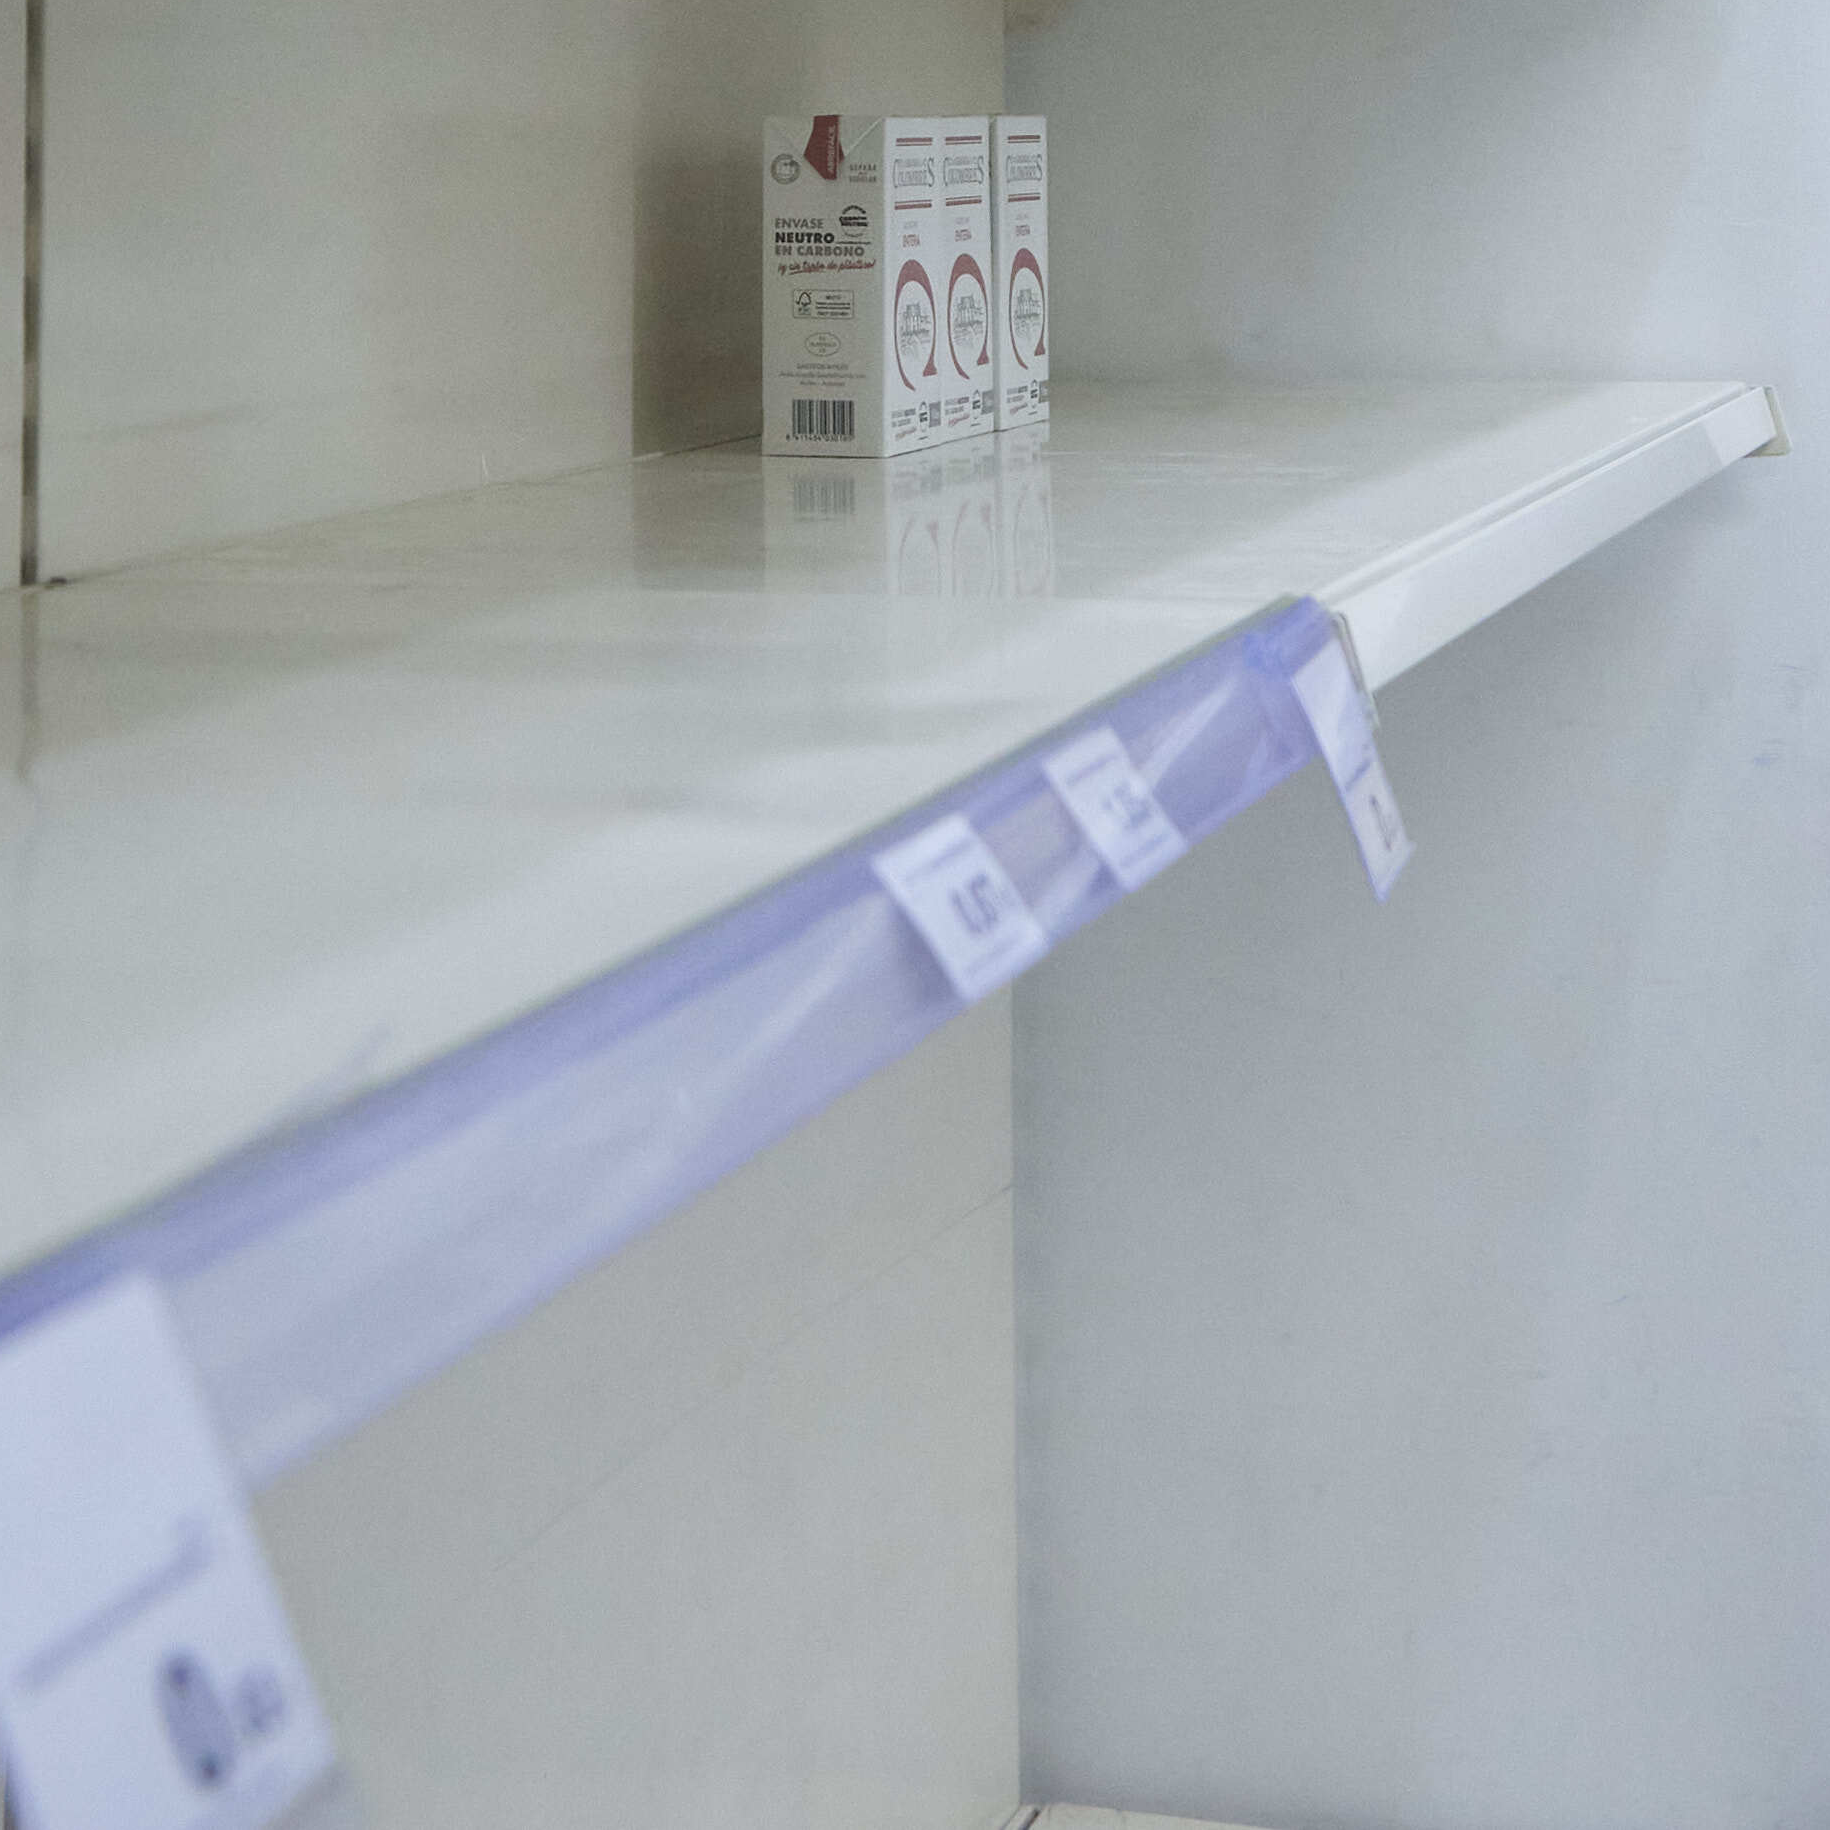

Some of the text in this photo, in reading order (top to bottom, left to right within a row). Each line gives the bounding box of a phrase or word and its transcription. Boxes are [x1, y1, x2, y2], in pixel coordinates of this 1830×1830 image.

[774, 218, 824, 229] ENVASE
[774, 232, 835, 244] NEUTRO
[774, 245, 865, 257] EN CARBONO
